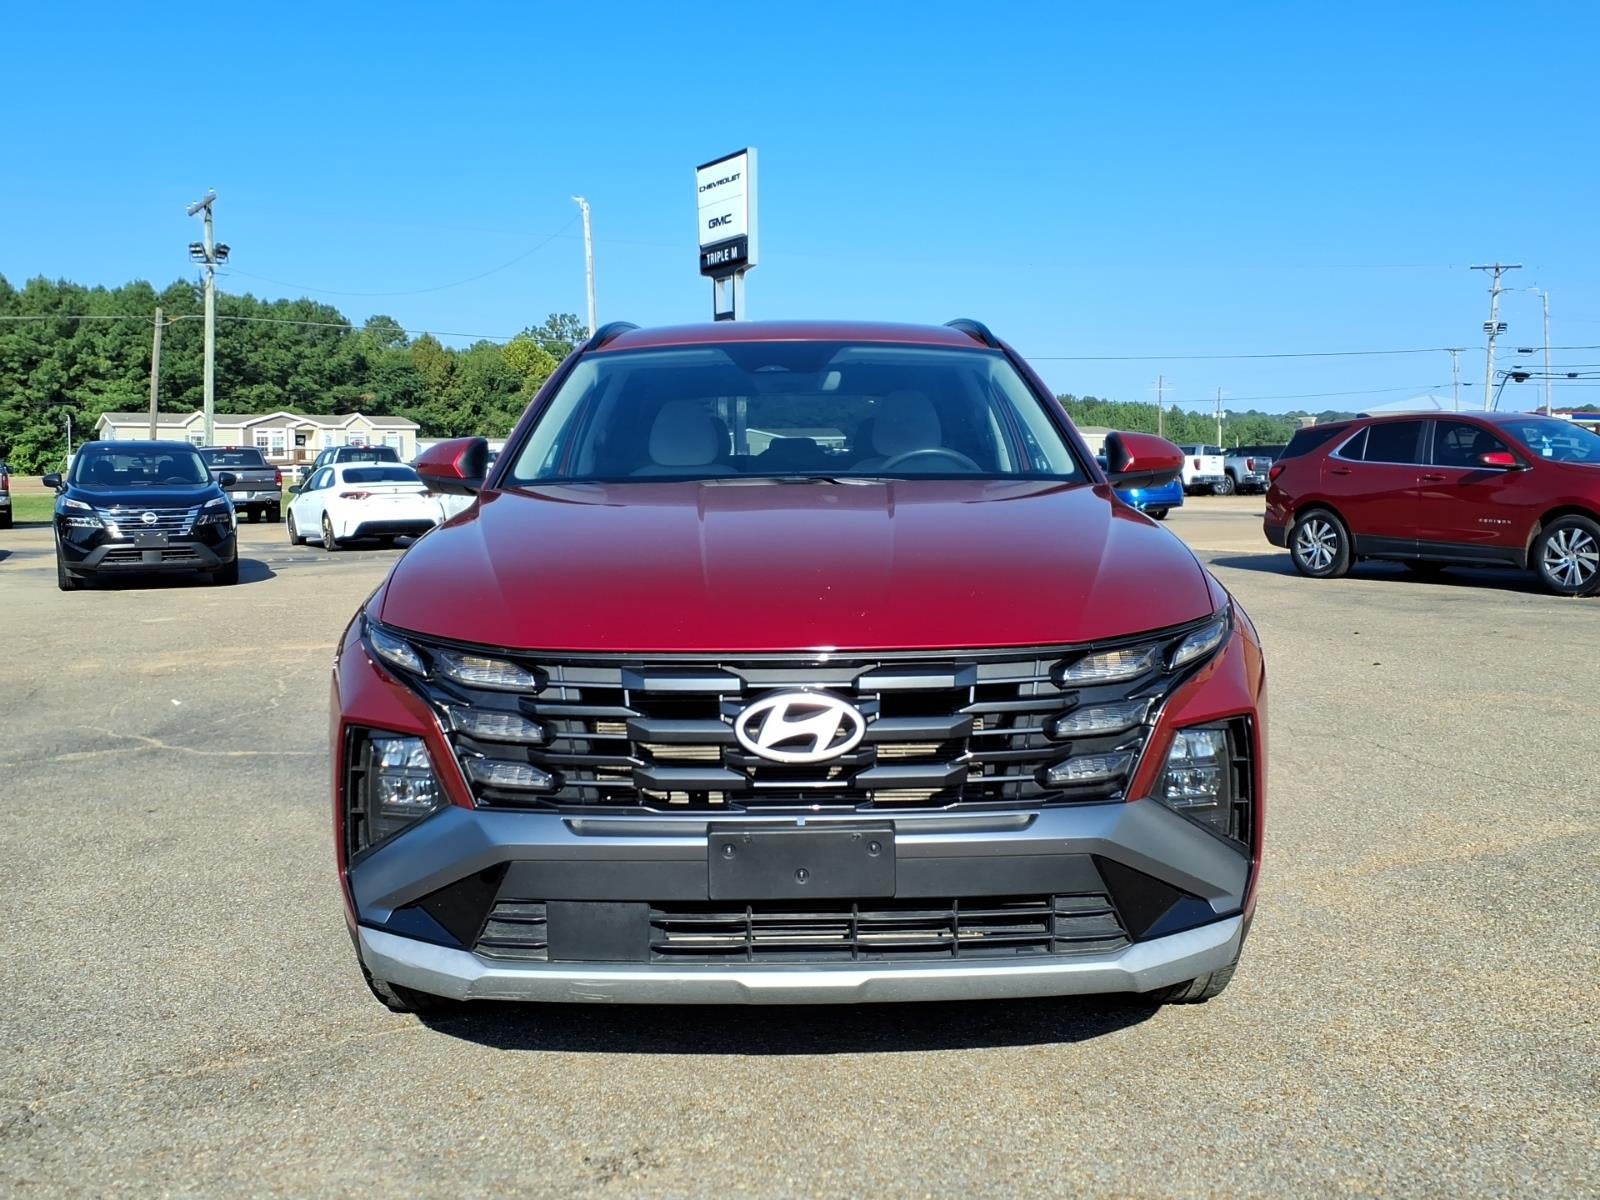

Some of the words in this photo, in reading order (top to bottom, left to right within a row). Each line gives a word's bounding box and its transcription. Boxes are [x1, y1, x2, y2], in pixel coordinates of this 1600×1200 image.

[699, 173, 741, 193] CHEVROLET
[708, 213, 732, 229] GMC
[706, 248, 729, 265] TRIPLE
[731, 246, 738, 259] M
